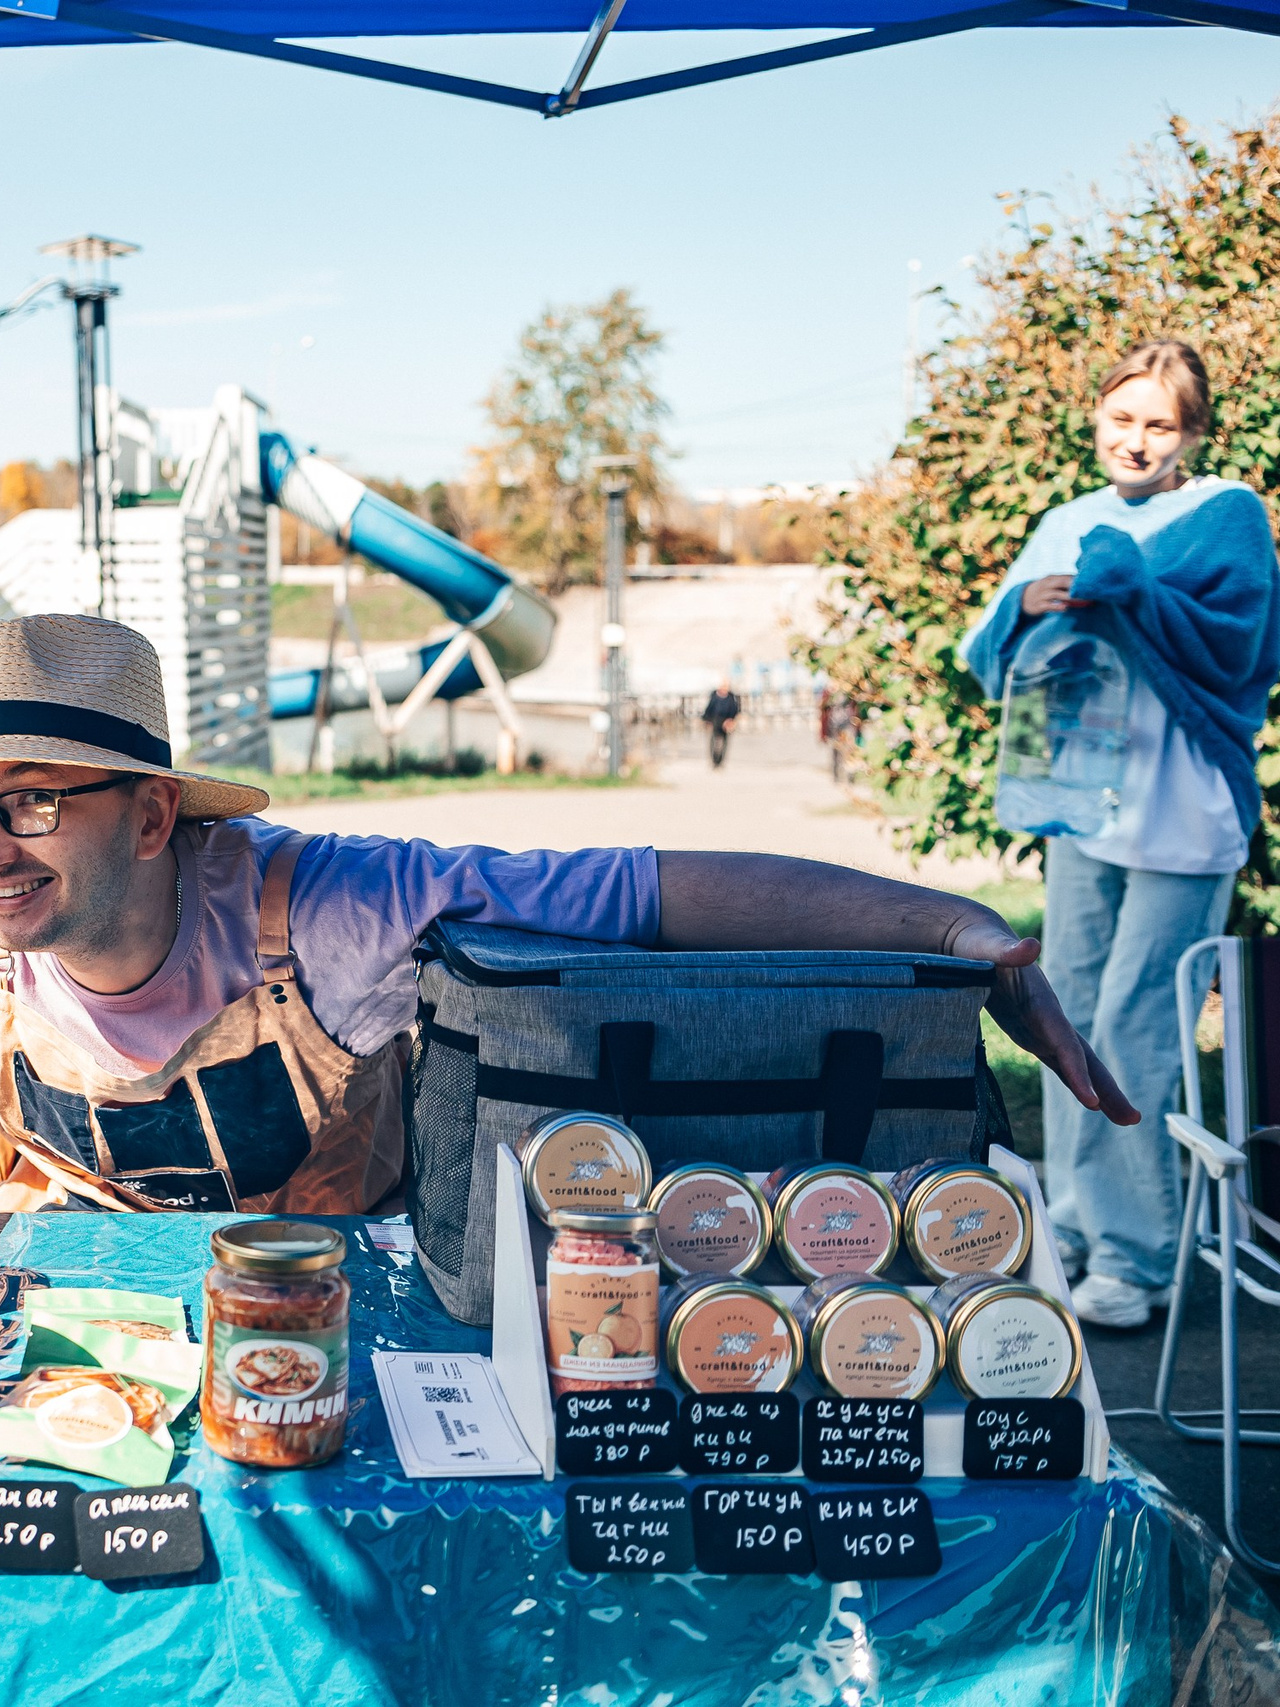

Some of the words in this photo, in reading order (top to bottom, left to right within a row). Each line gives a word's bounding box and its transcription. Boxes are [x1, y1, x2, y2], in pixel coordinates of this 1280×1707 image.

[554, 1186, 617, 1196] craft&food
[676, 1234, 739, 1248] craft&food
[809, 1235, 869, 1248] craft&food
[943, 1230, 1002, 1257] craft&food
[580, 1291, 639, 1300] craft&food
[700, 1360, 766, 1371] craft&food
[845, 1360, 910, 1372] craft&food
[985, 1356, 1048, 1378] craft&food
[233, 1390, 346, 1425] КИМЧИ
[594, 1444, 629, 1461] 380
[994, 1454, 1028, 1472] 175
[736, 1524, 777, 1549] 150
